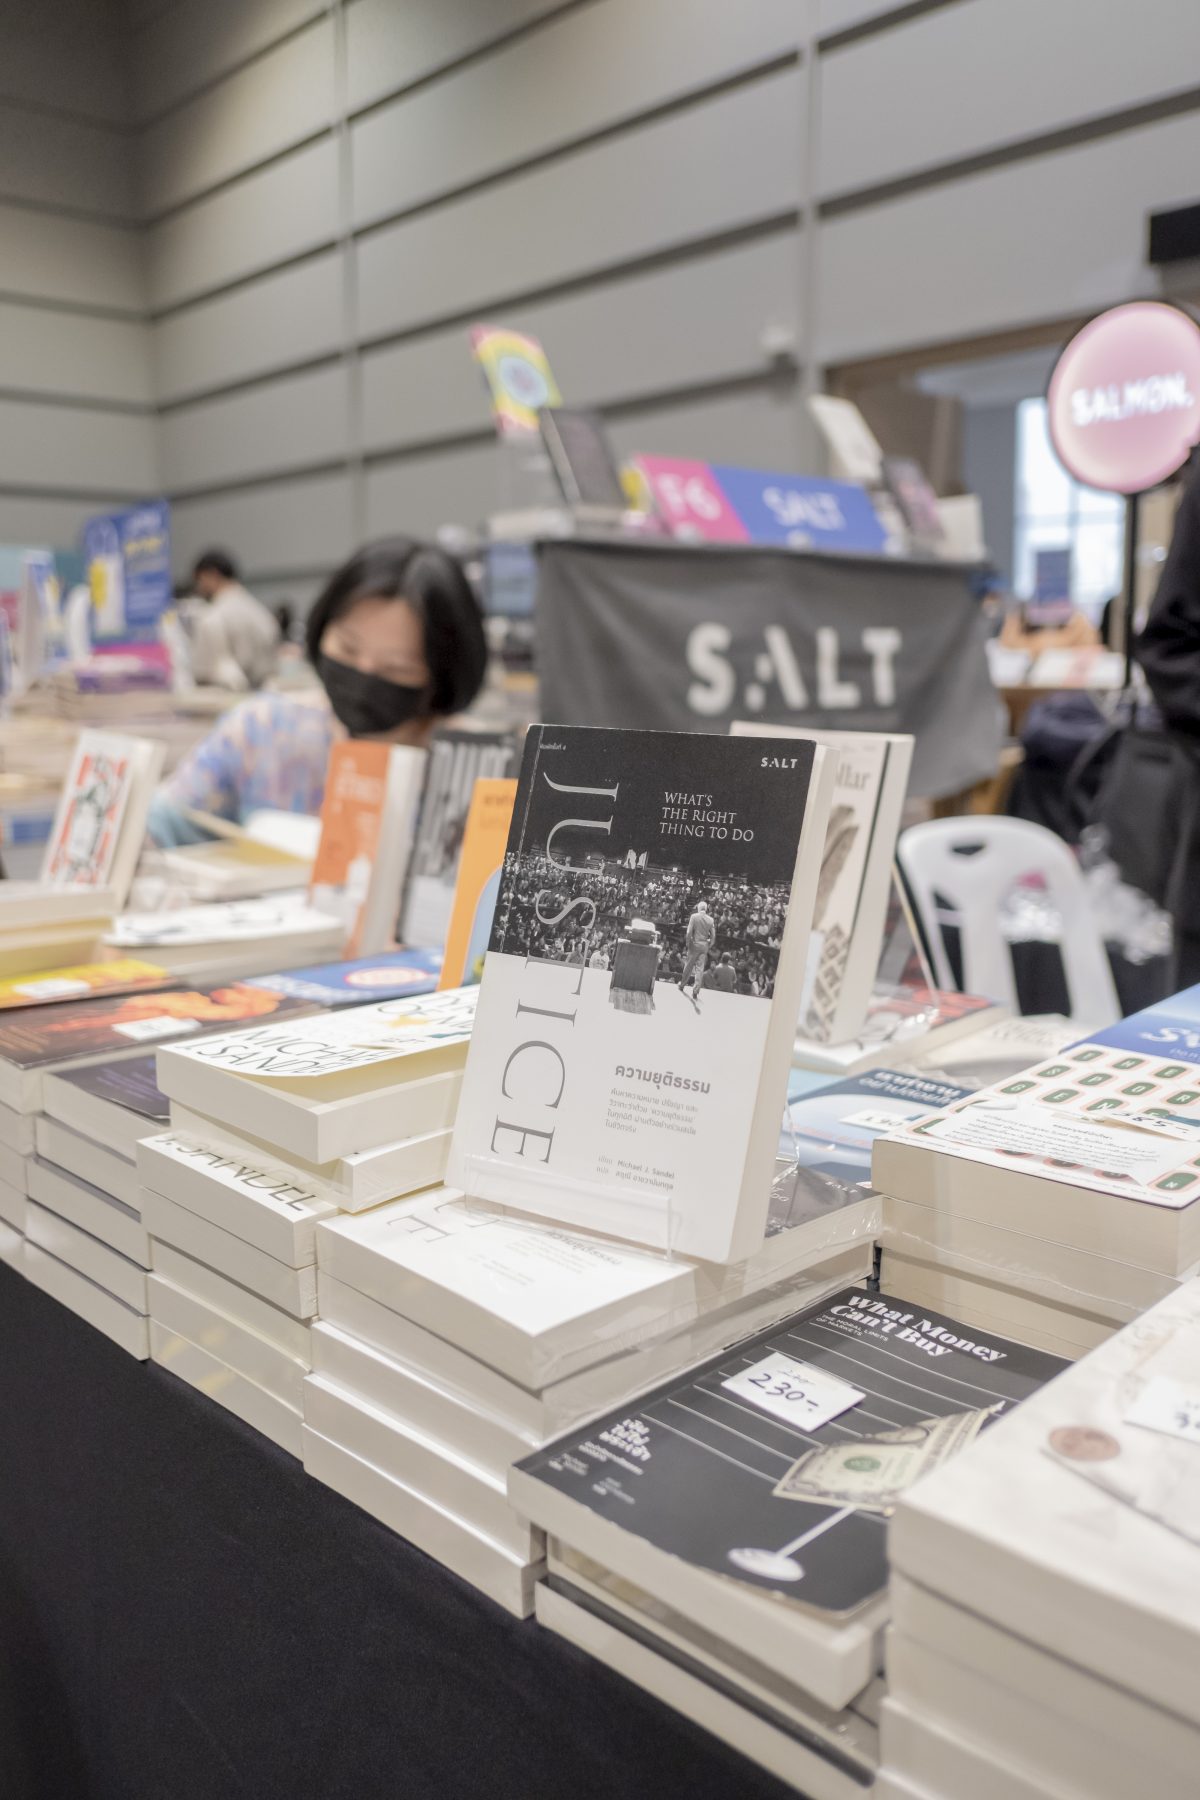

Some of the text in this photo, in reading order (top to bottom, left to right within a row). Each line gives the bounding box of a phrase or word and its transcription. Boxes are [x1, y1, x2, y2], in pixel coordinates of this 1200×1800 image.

[686, 622, 903, 715] SALT
[760, 756, 799, 770] SALT
[664, 791, 713, 808] WHAT'S
[661, 806, 738, 825] THE RIGHT
[659, 821, 755, 843] THING TO DO
[490, 771, 620, 1165] JUSTICE
[615, 1065, 711, 1094] ความยุติธรรม
[617, 1159, 643, 1173] Michael
[652, 1167, 675, 1180] Sandel
[821, 1314, 889, 1342] THE MORAL LIMITS
[828, 1320, 864, 1336] MARKETS
[829, 1305, 955, 1357] Can't Buy
[848, 1296, 1008, 1362] What Money
